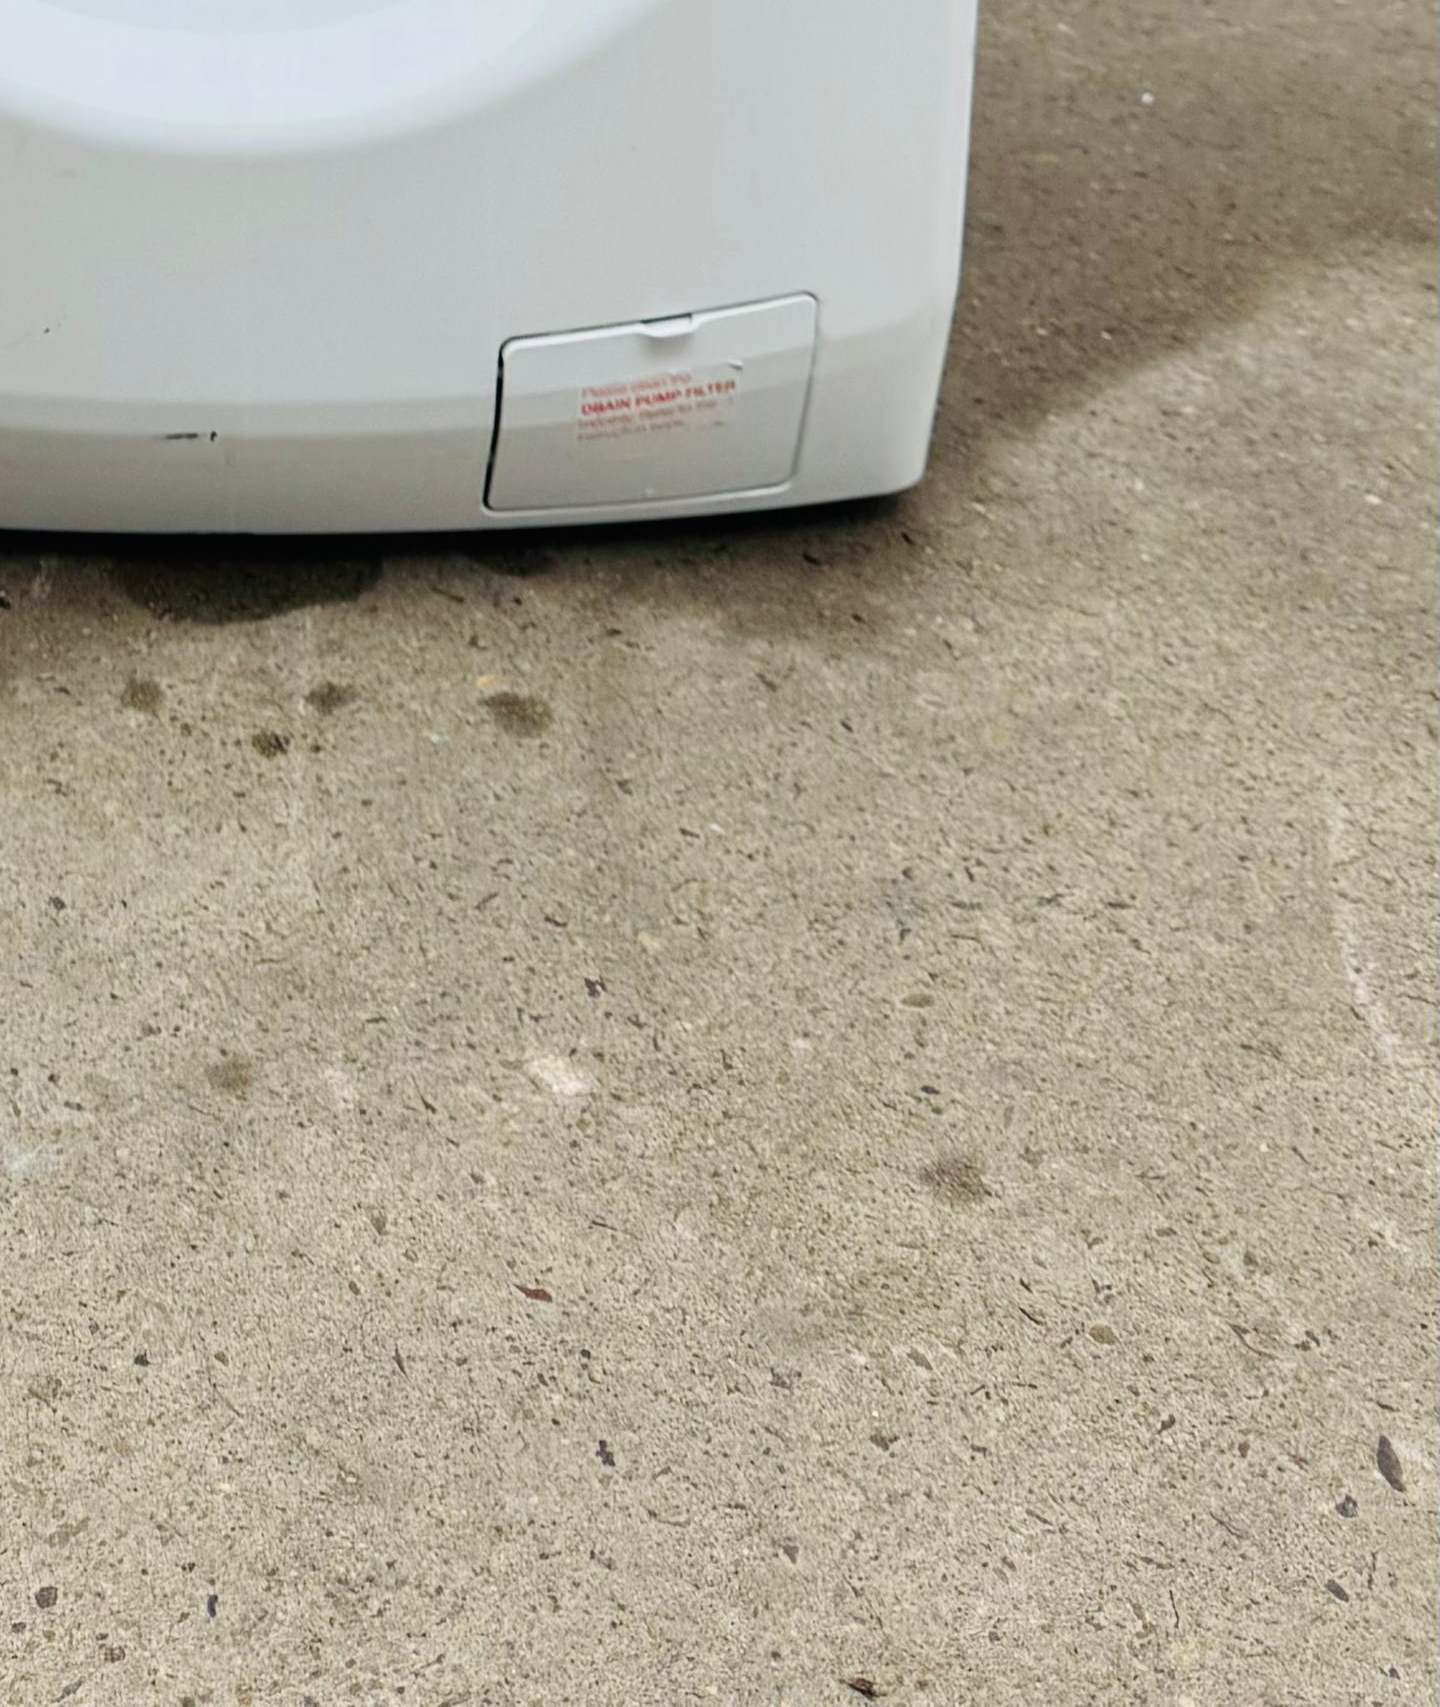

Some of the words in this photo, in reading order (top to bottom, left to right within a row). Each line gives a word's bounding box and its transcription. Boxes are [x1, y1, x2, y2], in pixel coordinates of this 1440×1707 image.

[580, 397, 630, 416] DRAIN
[635, 389, 682, 407] PUMP
[685, 380, 737, 397] FILTER
